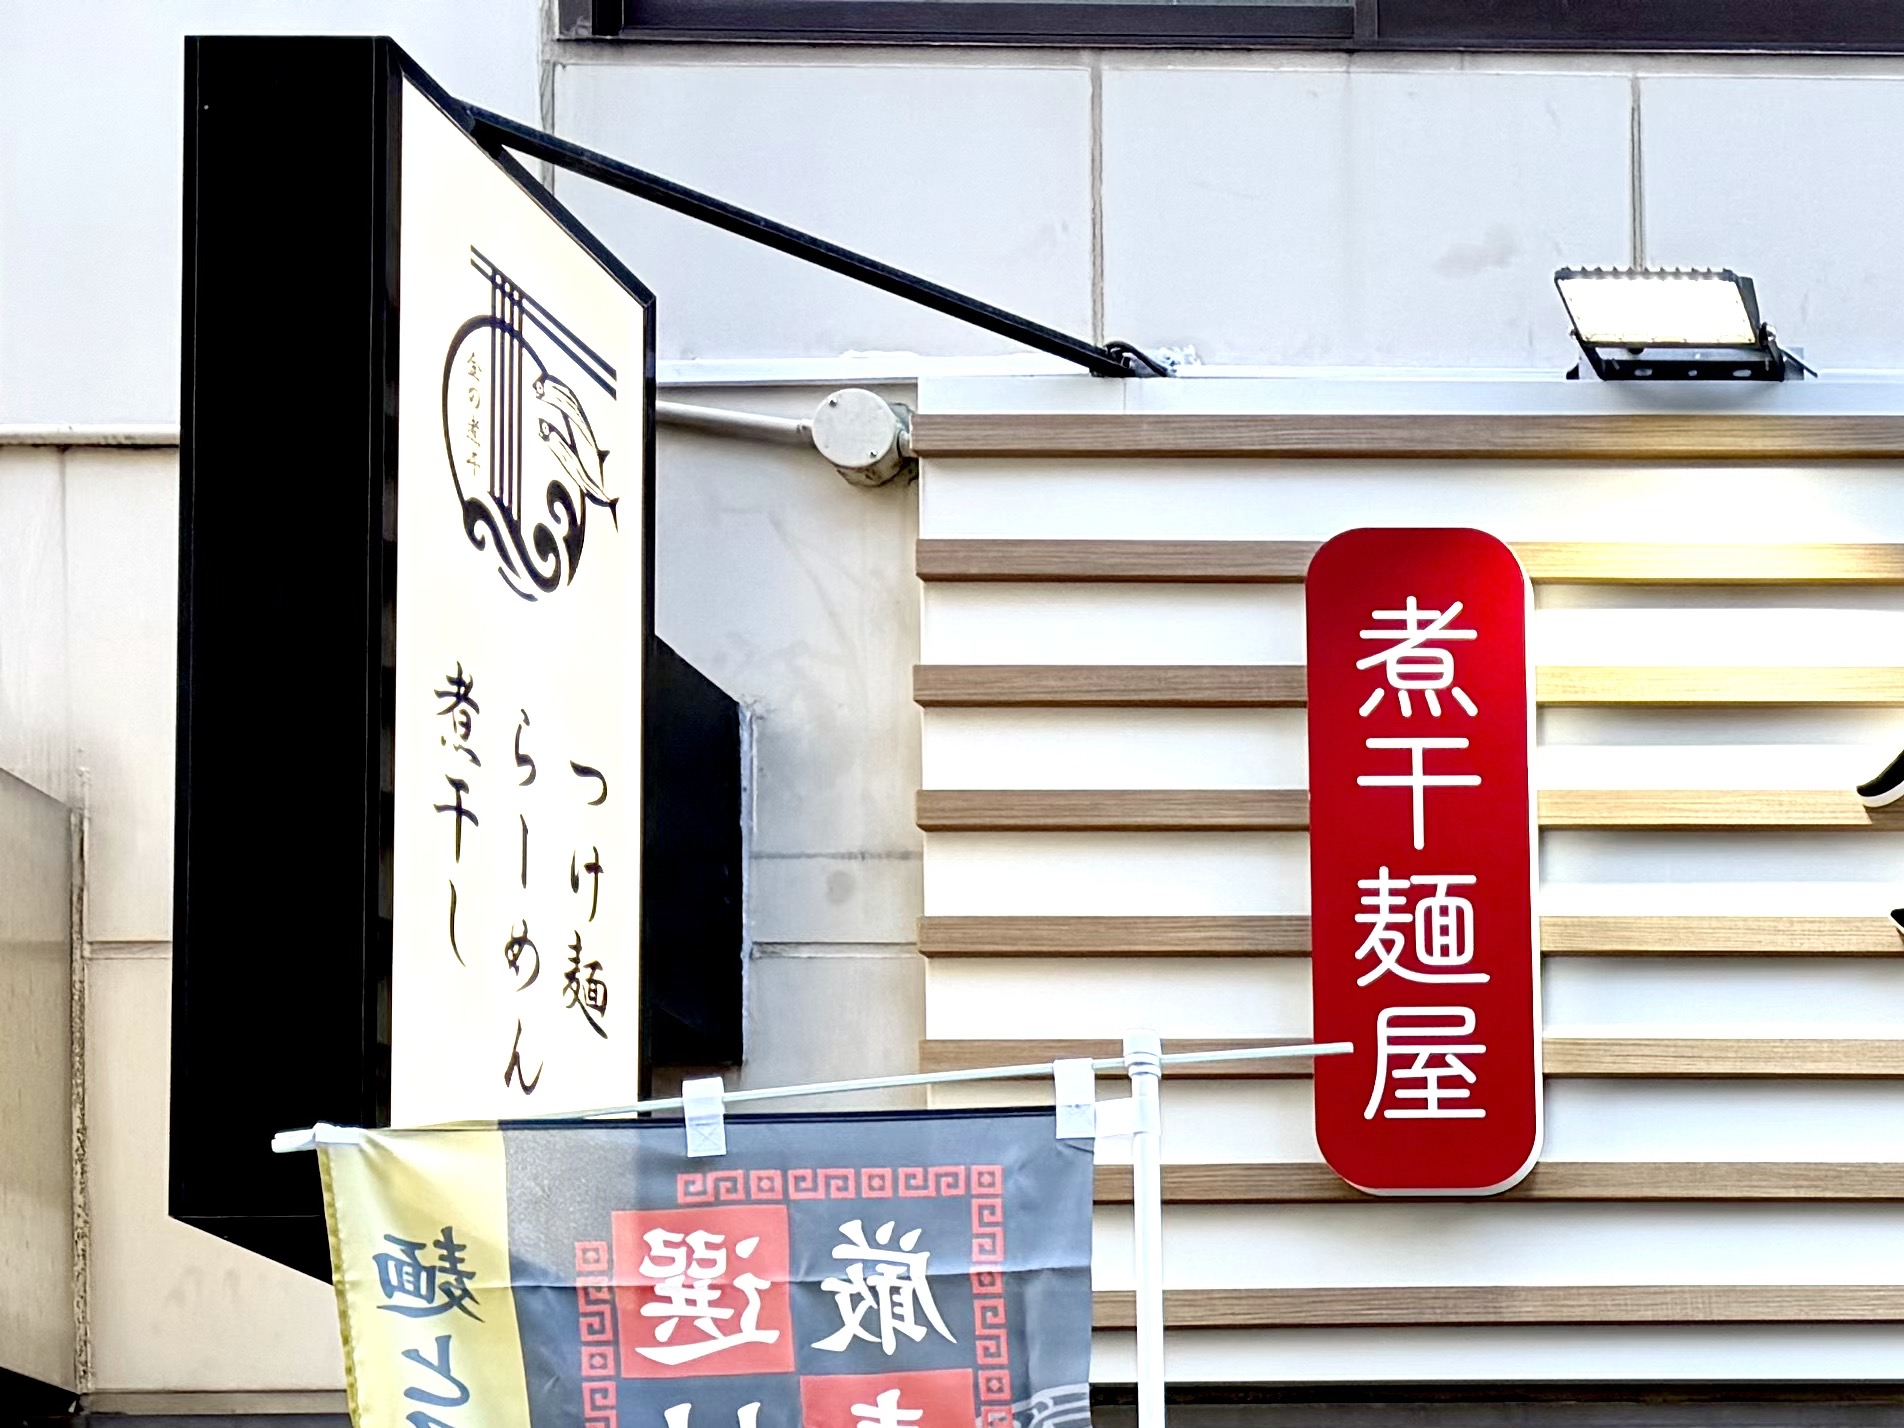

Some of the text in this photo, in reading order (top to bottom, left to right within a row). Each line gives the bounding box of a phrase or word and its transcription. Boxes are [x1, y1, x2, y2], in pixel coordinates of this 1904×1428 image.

[433, 660, 481, 967] 煮干し
[504, 708, 544, 1096] らーめん
[563, 760, 608, 1040] つけ麺
[1355, 595, 1491, 1121] 煮干麺屋
